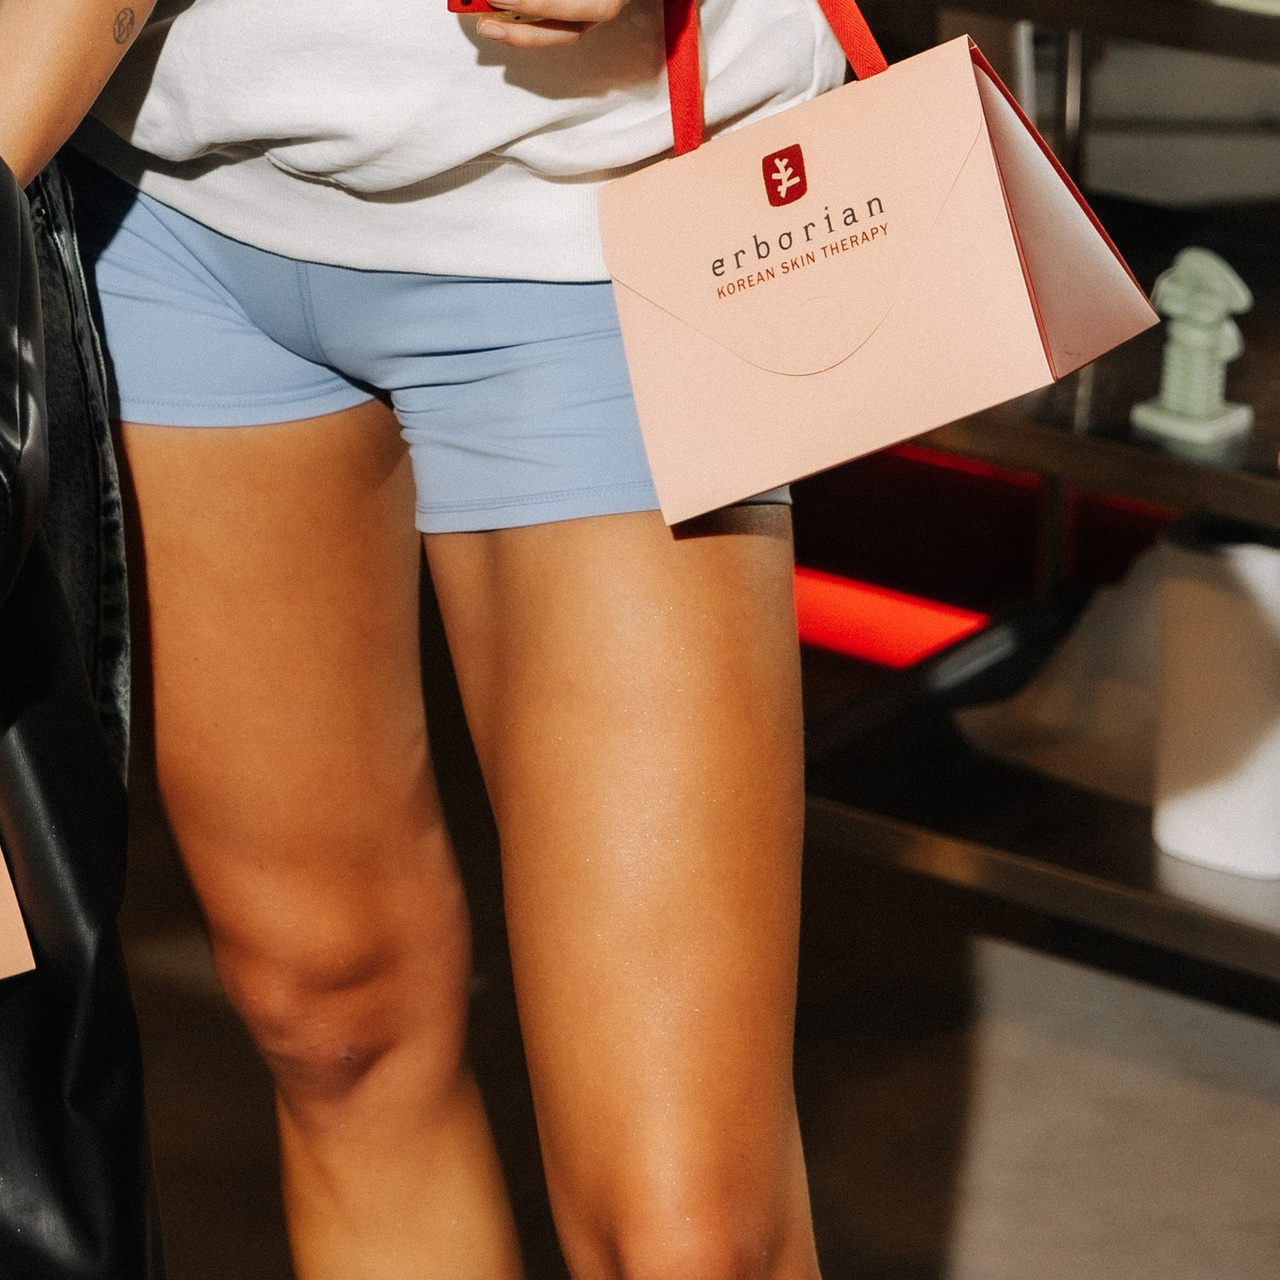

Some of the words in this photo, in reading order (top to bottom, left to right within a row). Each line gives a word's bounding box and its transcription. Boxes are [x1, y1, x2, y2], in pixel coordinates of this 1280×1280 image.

[711, 196, 886, 277] erborian
[716, 266, 776, 300] KOREAN
[780, 251, 817, 275] SKIN
[820, 222, 890, 260] THERAPY
